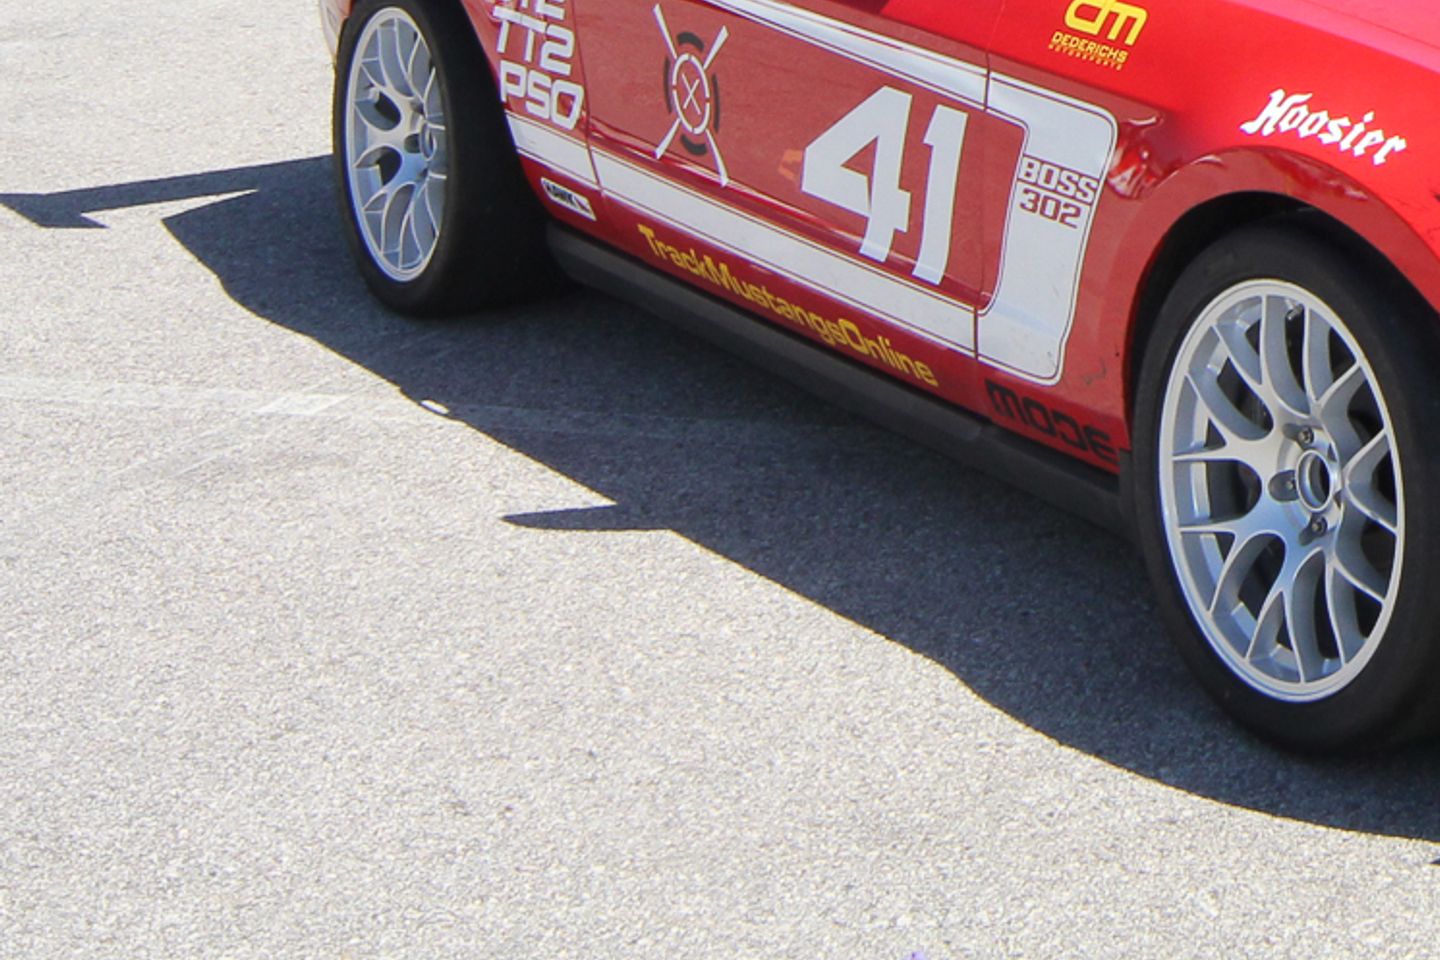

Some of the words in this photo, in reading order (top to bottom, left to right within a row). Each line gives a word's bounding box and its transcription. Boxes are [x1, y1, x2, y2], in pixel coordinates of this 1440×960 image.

[492, 5, 575, 76] TT2
[1052, 31, 1129, 64] DEDERICHS
[1239, 89, 1408, 165] Hoosier
[802, 85, 968, 286] 41
[1018, 156, 1099, 204] BOSS
[1019, 187, 1081, 230] 302
